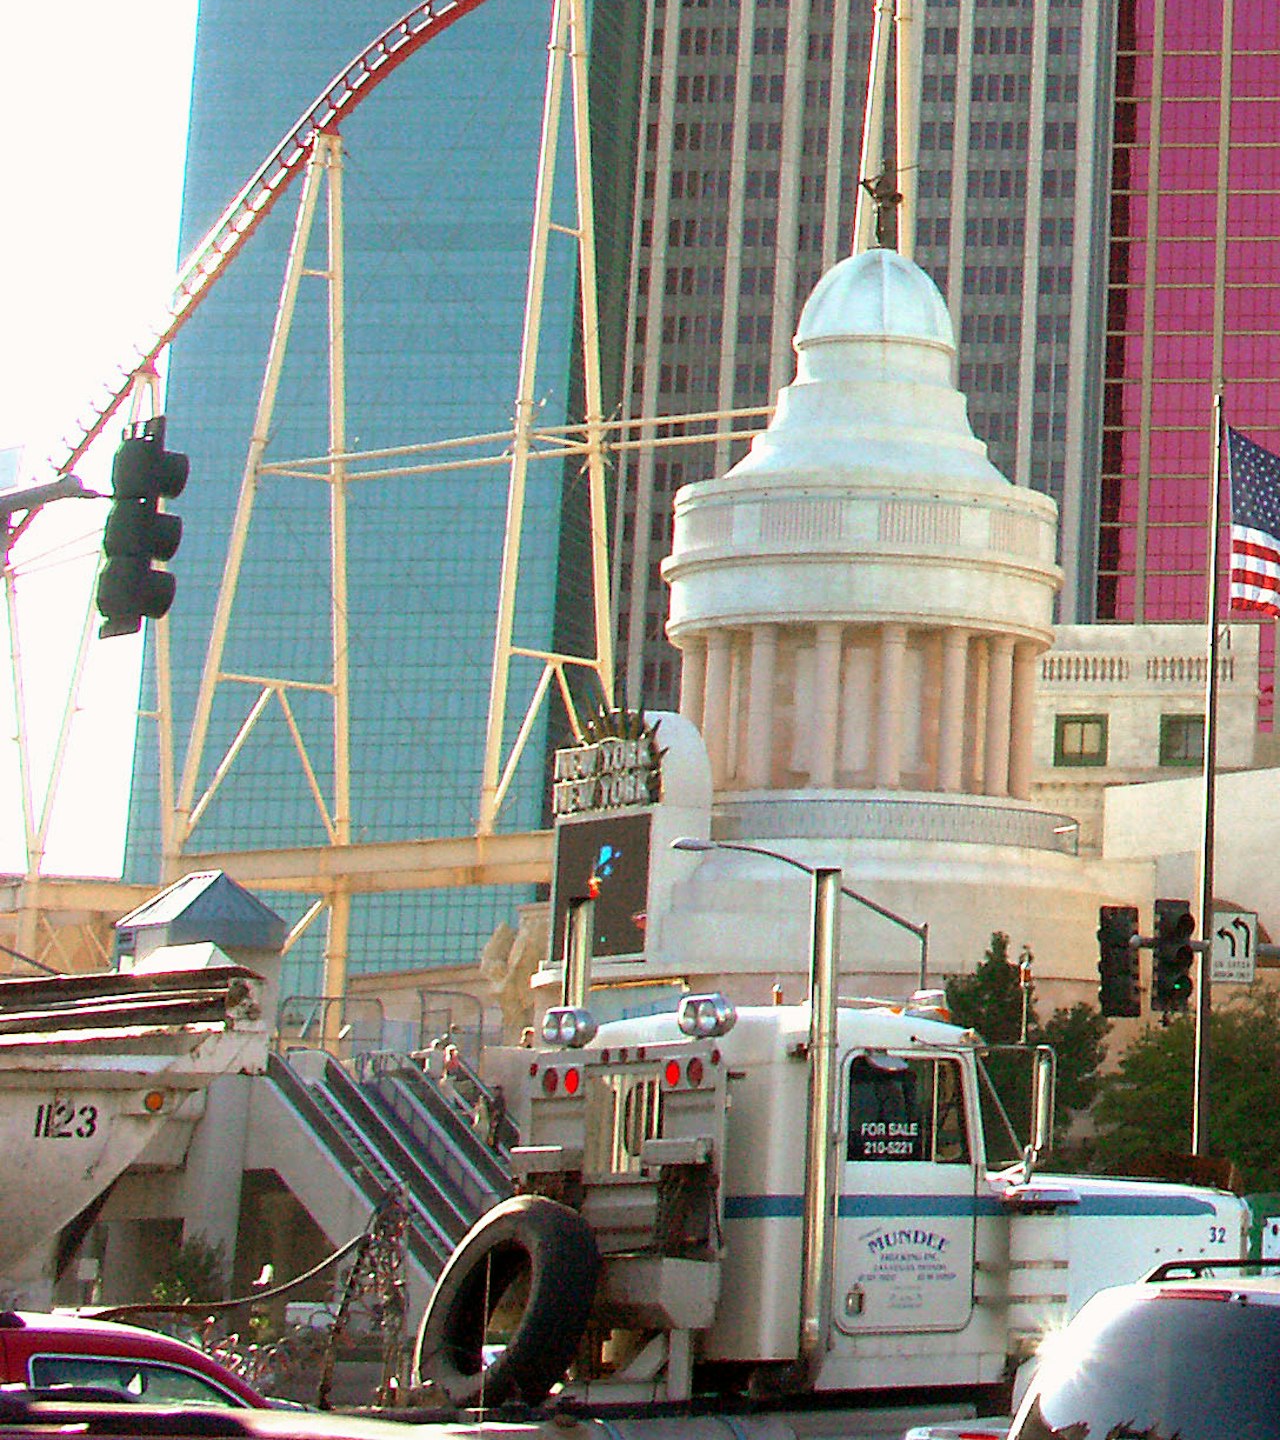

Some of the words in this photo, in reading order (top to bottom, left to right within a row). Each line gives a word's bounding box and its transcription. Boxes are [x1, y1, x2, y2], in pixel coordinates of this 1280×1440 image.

[555, 748, 597, 780] NEW
[599, 739, 652, 771] YORK
[554, 781, 596, 813] NEW
[599, 772, 651, 806] YORK
[35, 1104, 98, 1138] 1123
[861, 1122, 886, 1136] FOR
[888, 1122, 918, 1136] SALE
[864, 1141, 914, 1155] 210-5221
[1209, 1226, 1226, 1243] 32
